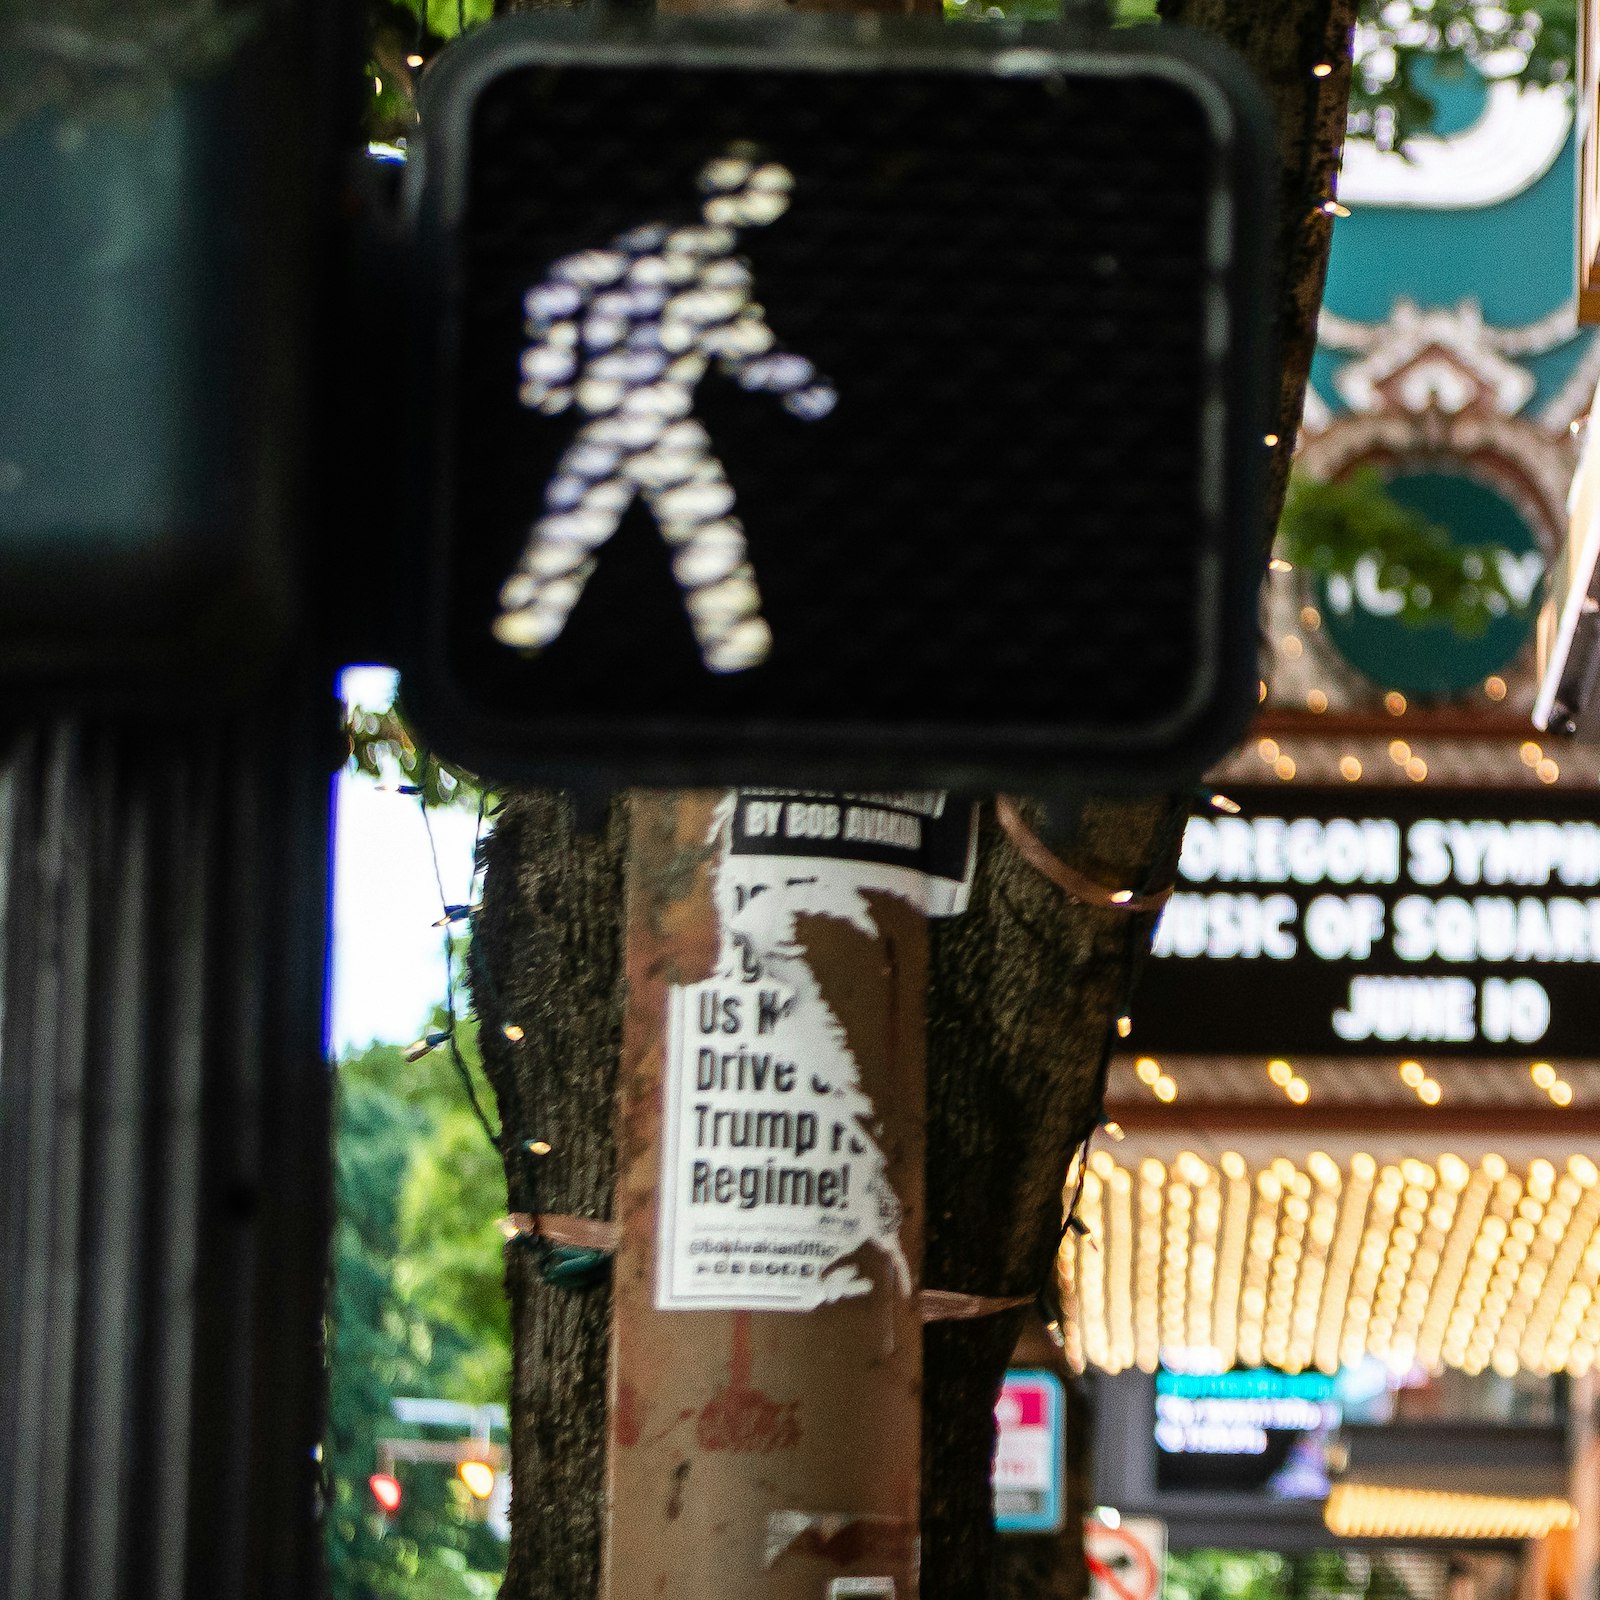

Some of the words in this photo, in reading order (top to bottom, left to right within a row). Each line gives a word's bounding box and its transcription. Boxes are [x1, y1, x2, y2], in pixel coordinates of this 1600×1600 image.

[1178, 816, 1400, 884] OREGON
[1304, 893, 1384, 960] OF
[699, 989, 742, 1035] Us
[1331, 973, 1476, 1042] JUNE
[1481, 976, 1550, 1043] 10
[697, 1043, 796, 1092] Drive
[693, 1104, 818, 1157] Trump
[691, 1157, 850, 1209] Regime!
